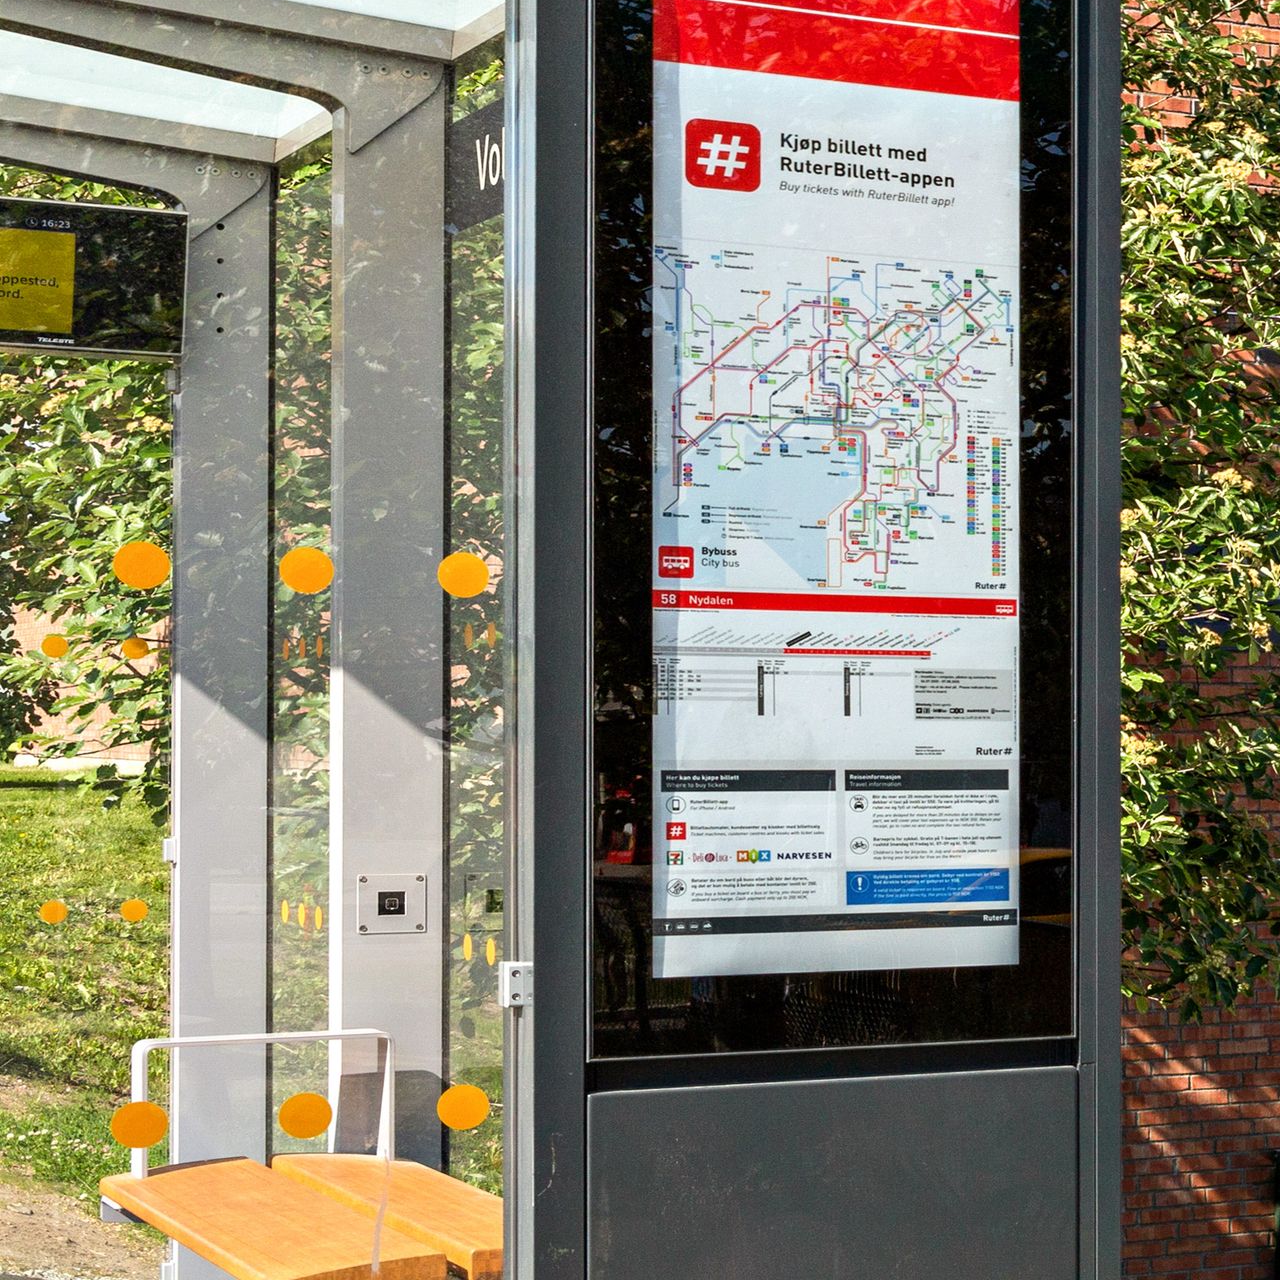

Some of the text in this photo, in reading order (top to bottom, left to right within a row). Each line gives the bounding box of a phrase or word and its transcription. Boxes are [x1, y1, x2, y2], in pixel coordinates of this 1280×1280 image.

[780, 133, 927, 162] Kjøp billett med
[780, 157, 955, 188] RuterBillett-appen
[779, 181, 955, 207] Buy tickets with RuterBillett app!
[41, 219, 71, 229] 16:23
[701, 547, 737, 557] Bybuss
[701, 558, 740, 568] City bus
[661, 594, 734, 606] 58 Nydalen
[777, 852, 832, 860] NARVESEN
